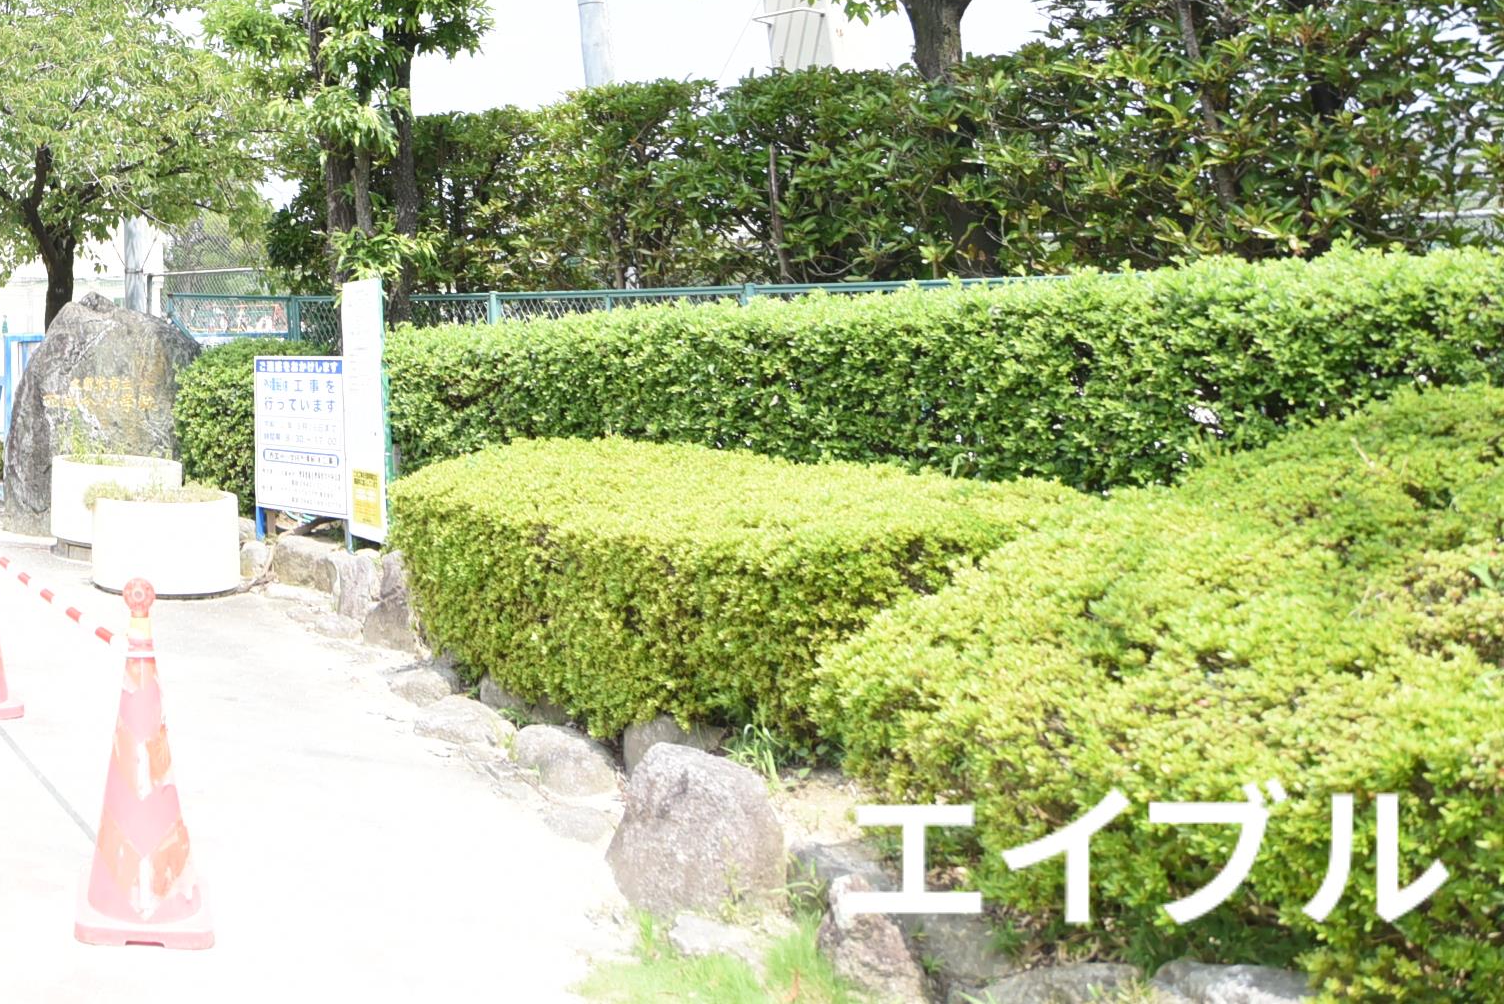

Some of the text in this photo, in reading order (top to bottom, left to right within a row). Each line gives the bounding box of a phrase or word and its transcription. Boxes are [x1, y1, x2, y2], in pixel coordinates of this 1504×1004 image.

[264, 396, 336, 413] 行っています
